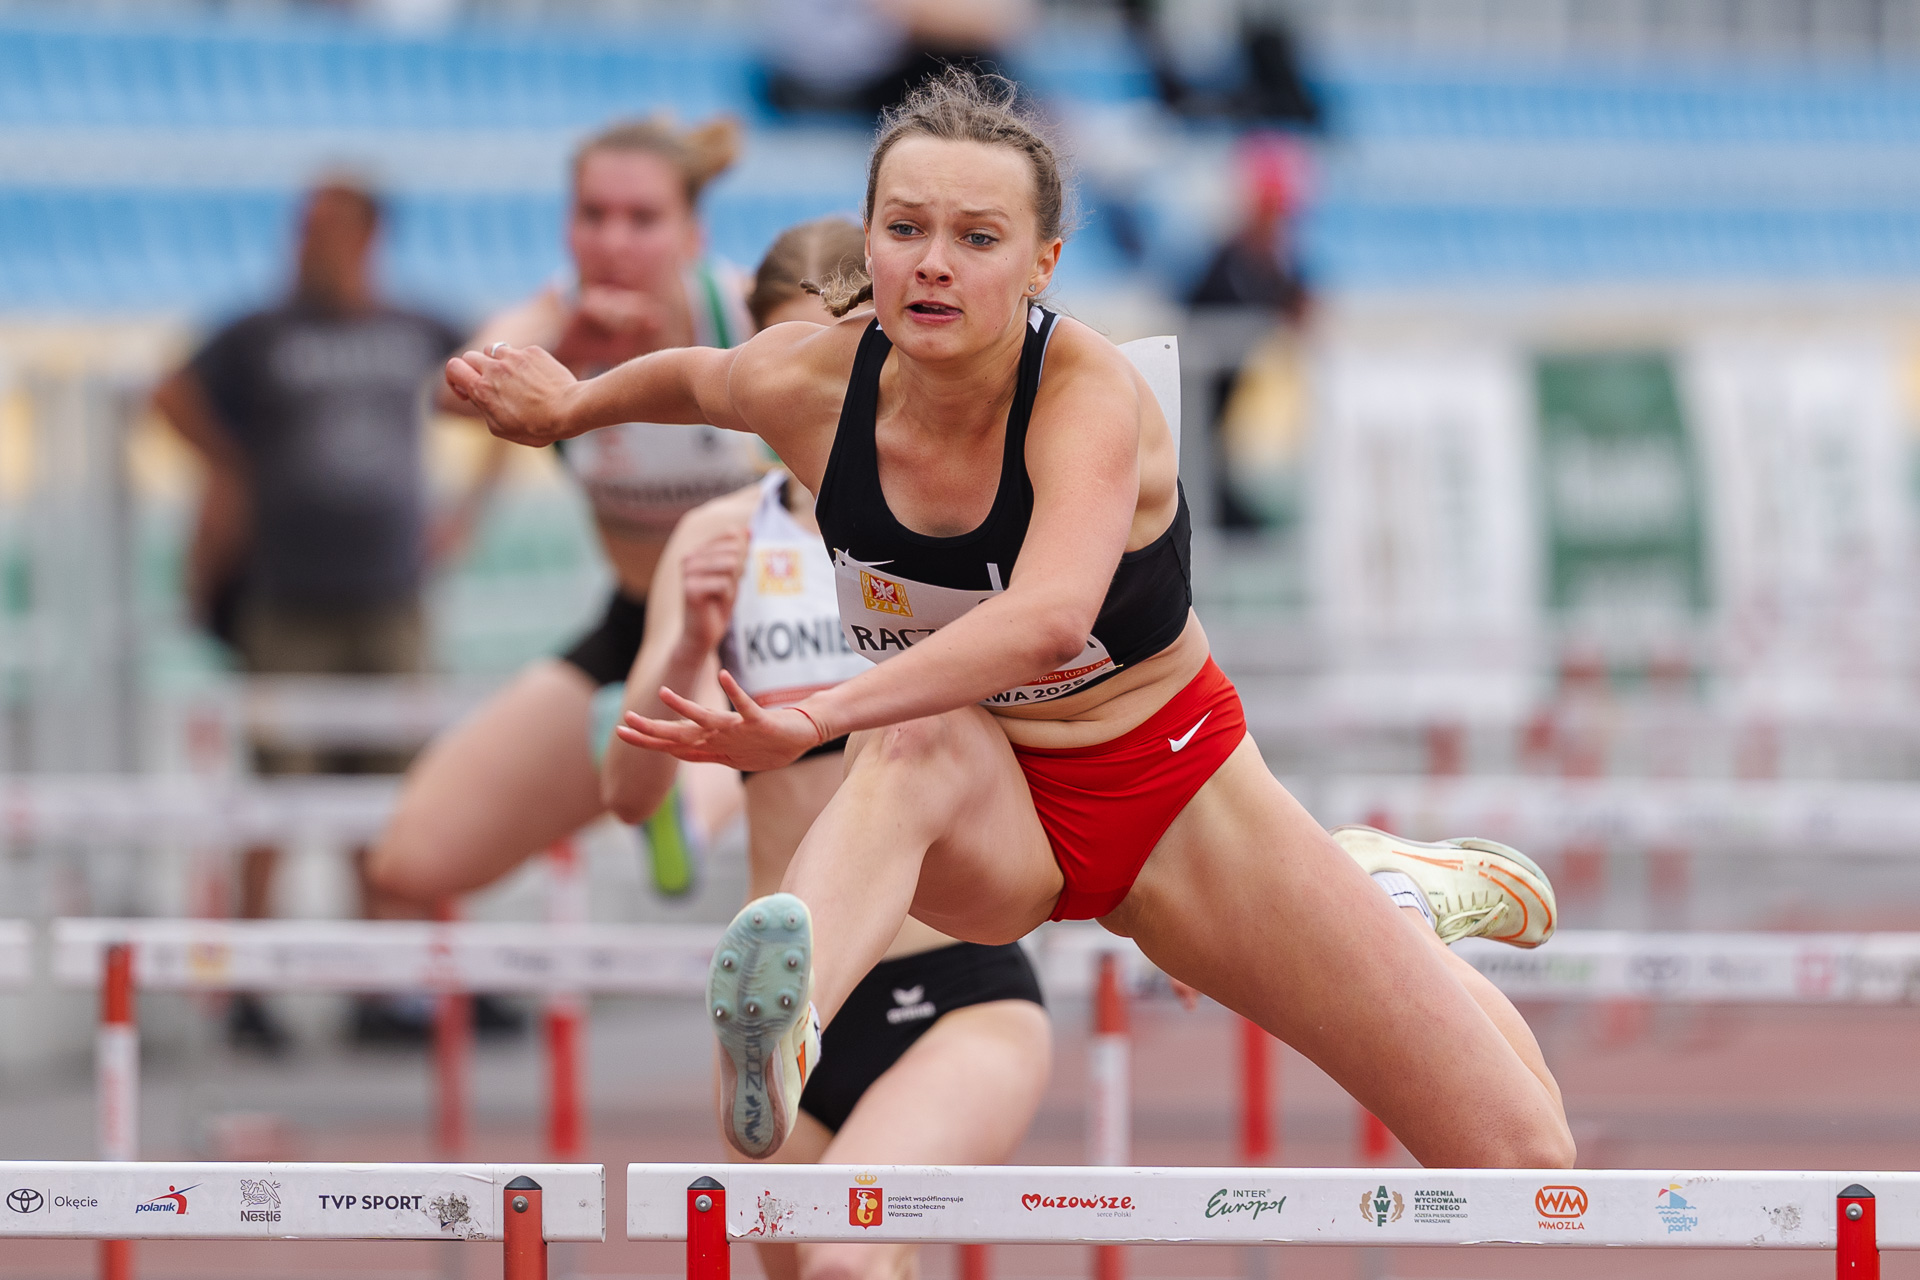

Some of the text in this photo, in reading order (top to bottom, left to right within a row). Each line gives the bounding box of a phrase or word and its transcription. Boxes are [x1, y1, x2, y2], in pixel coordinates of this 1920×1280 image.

[866, 598, 912, 616] PZLA
[985, 677, 1086, 703] WA 2025
[887, 1195, 912, 1203] projekt
[1232, 1189, 1267, 1198] INTER
[54, 1196, 98, 1209] Okęcie
[135, 1202, 176, 1214] polanik
[319, 1195, 423, 1210] TVP SPORT
[1204, 1188, 1287, 1220] Europol
[1537, 1220, 1586, 1231] WMOZLA
[1661, 1215, 1698, 1227] wodny
[1667, 1223, 1692, 1234] park
